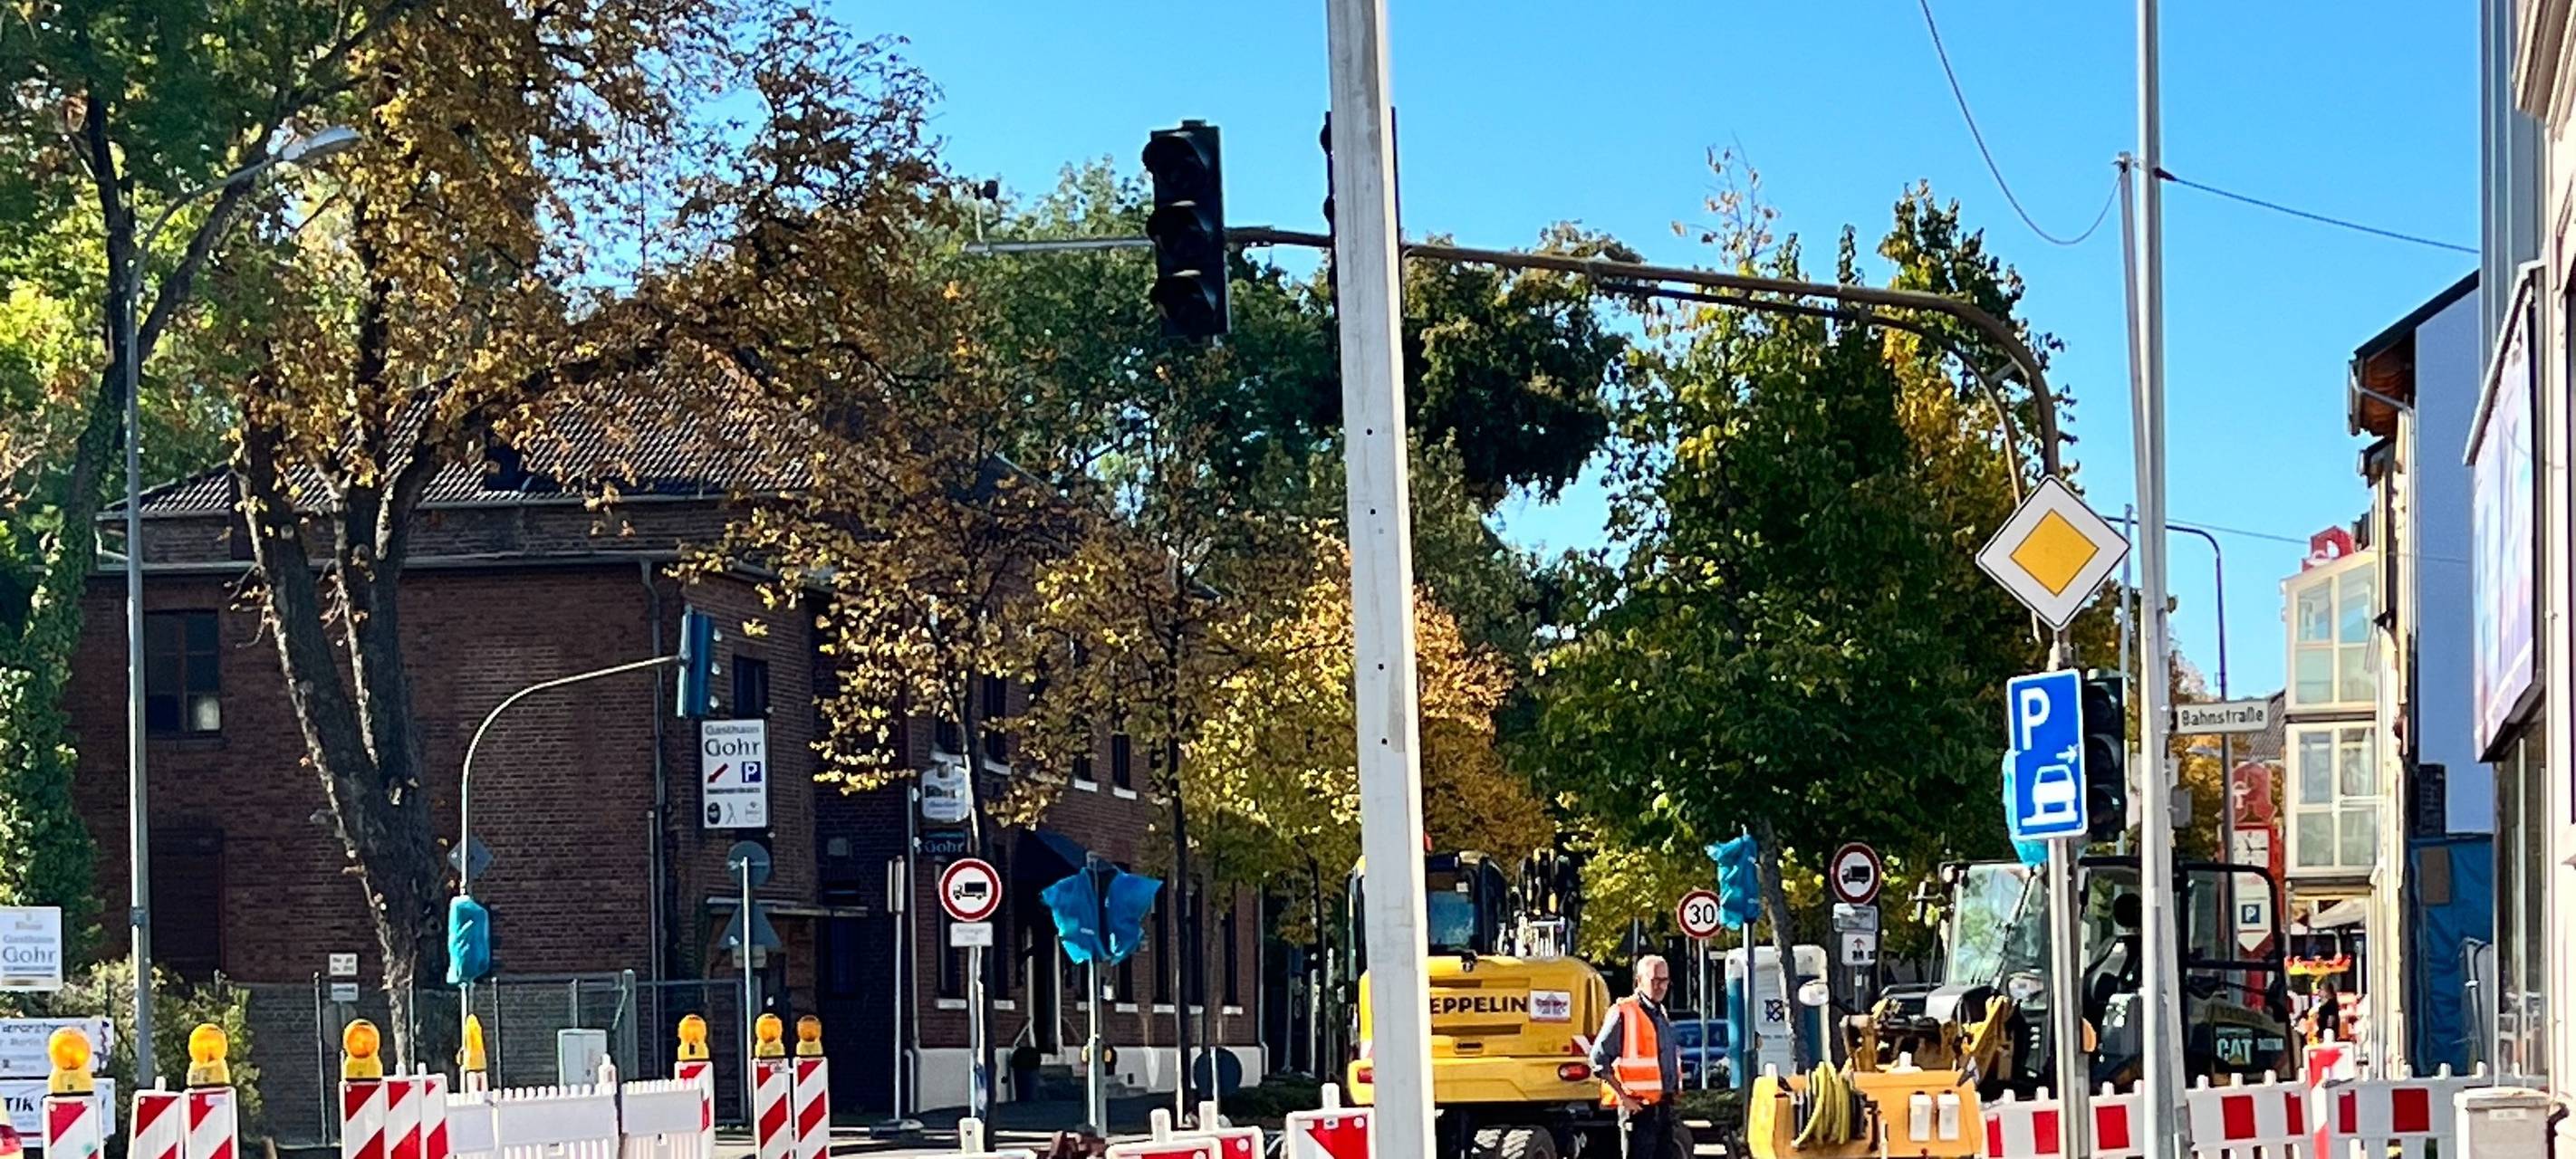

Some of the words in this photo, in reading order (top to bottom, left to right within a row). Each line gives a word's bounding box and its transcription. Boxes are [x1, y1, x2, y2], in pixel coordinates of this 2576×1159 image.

[2020, 686, 2051, 751] P
[2180, 706, 2264, 726] Bahnstraße
[705, 738, 761, 757] Gohr
[745, 762, 758, 782] P
[925, 840, 966, 853] Gohr
[1688, 903, 1716, 925] 30
[3, 946, 56, 963] Gohr
[1430, 995, 1527, 1014] EPPELIN
[2216, 1038, 2253, 1065] CAT
[4, 1097, 34, 1112] TIK
